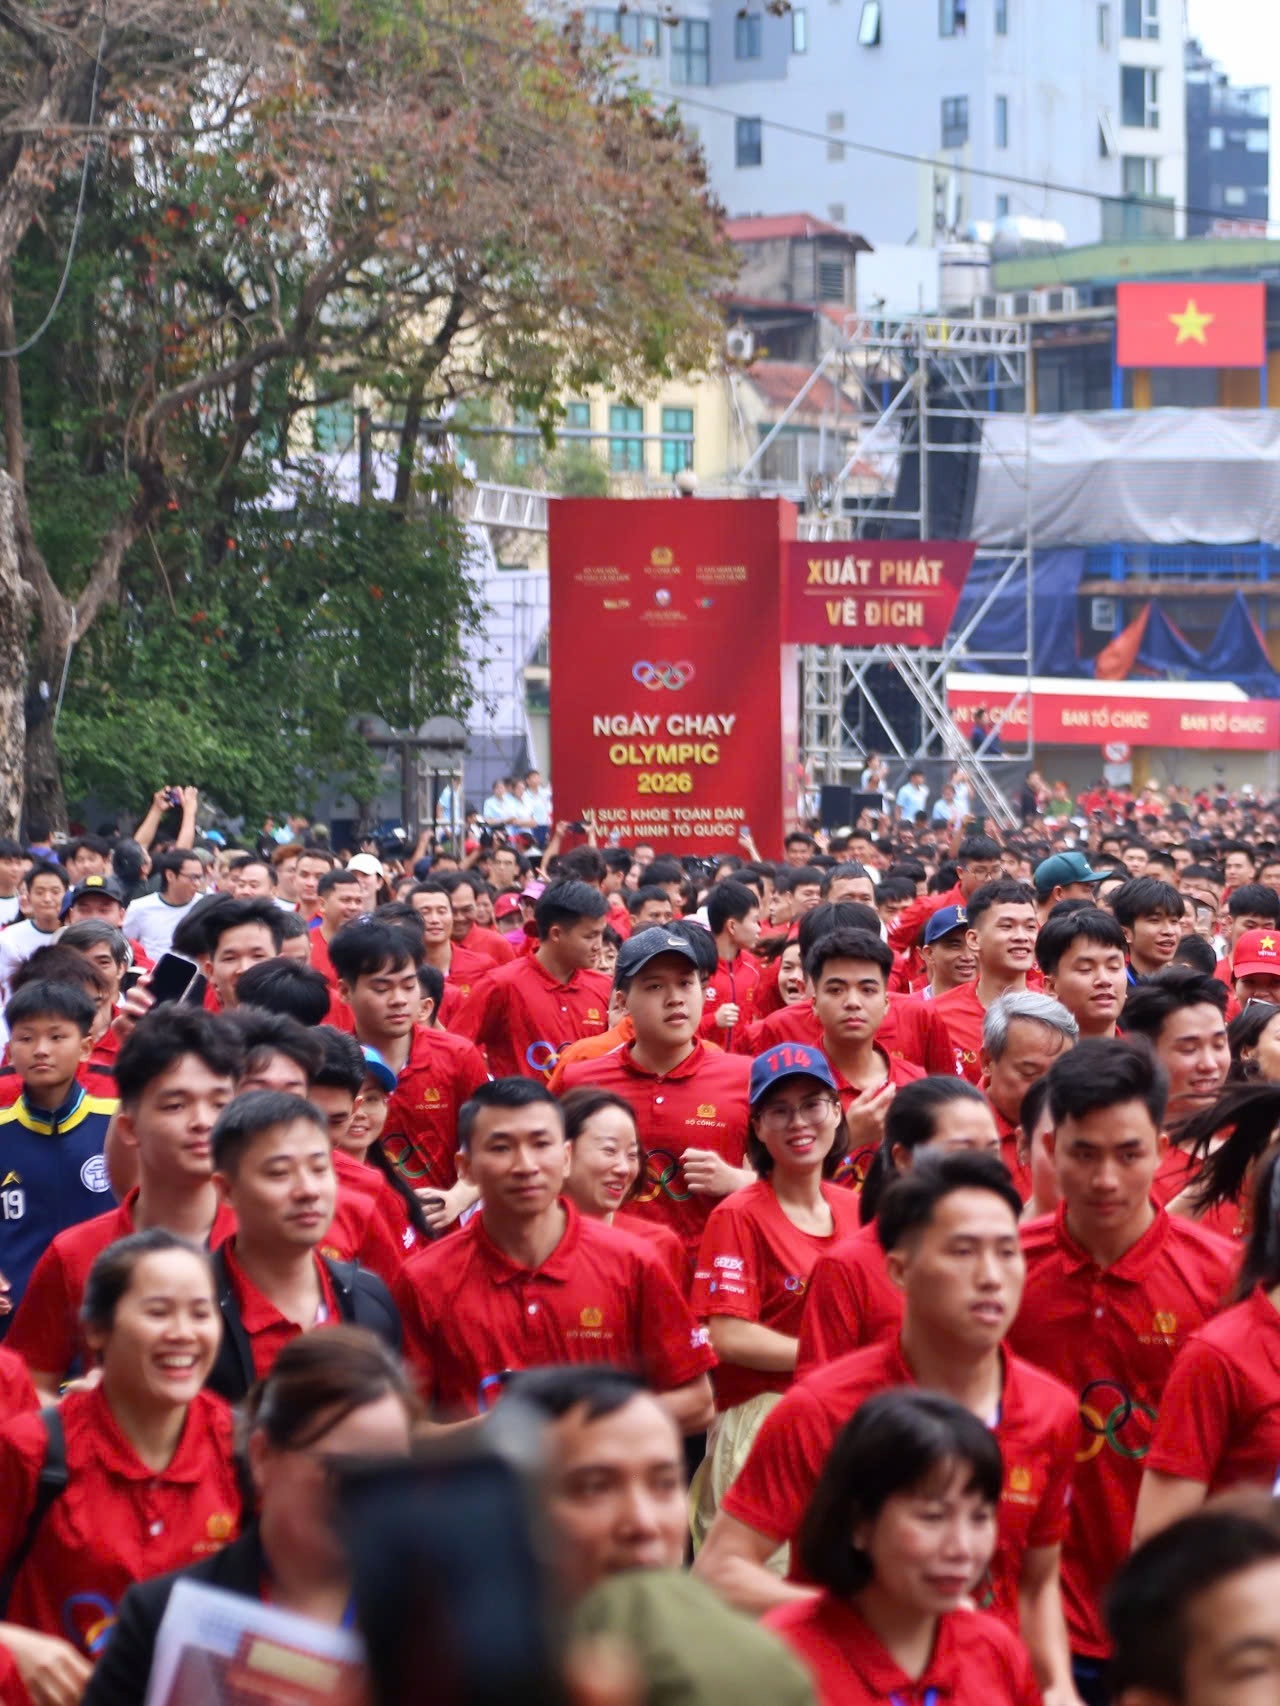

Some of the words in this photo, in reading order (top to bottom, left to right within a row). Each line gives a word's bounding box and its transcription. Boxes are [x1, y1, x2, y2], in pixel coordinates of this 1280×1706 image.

[807, 555, 872, 585] XUẤT
[879, 556, 943, 585] PHÁT
[825, 596, 857, 626] VỀ
[864, 598, 924, 627] ĐÍCH
[592, 711, 661, 737] NGÀY
[666, 713, 736, 739] CHẠY
[609, 743, 720, 765] OLYMPIC
[637, 772, 694, 794] 2026
[634, 823, 669, 837] NINH
[767, 1046, 812, 1072] 114
[0, 1190, 25, 1220] 19
